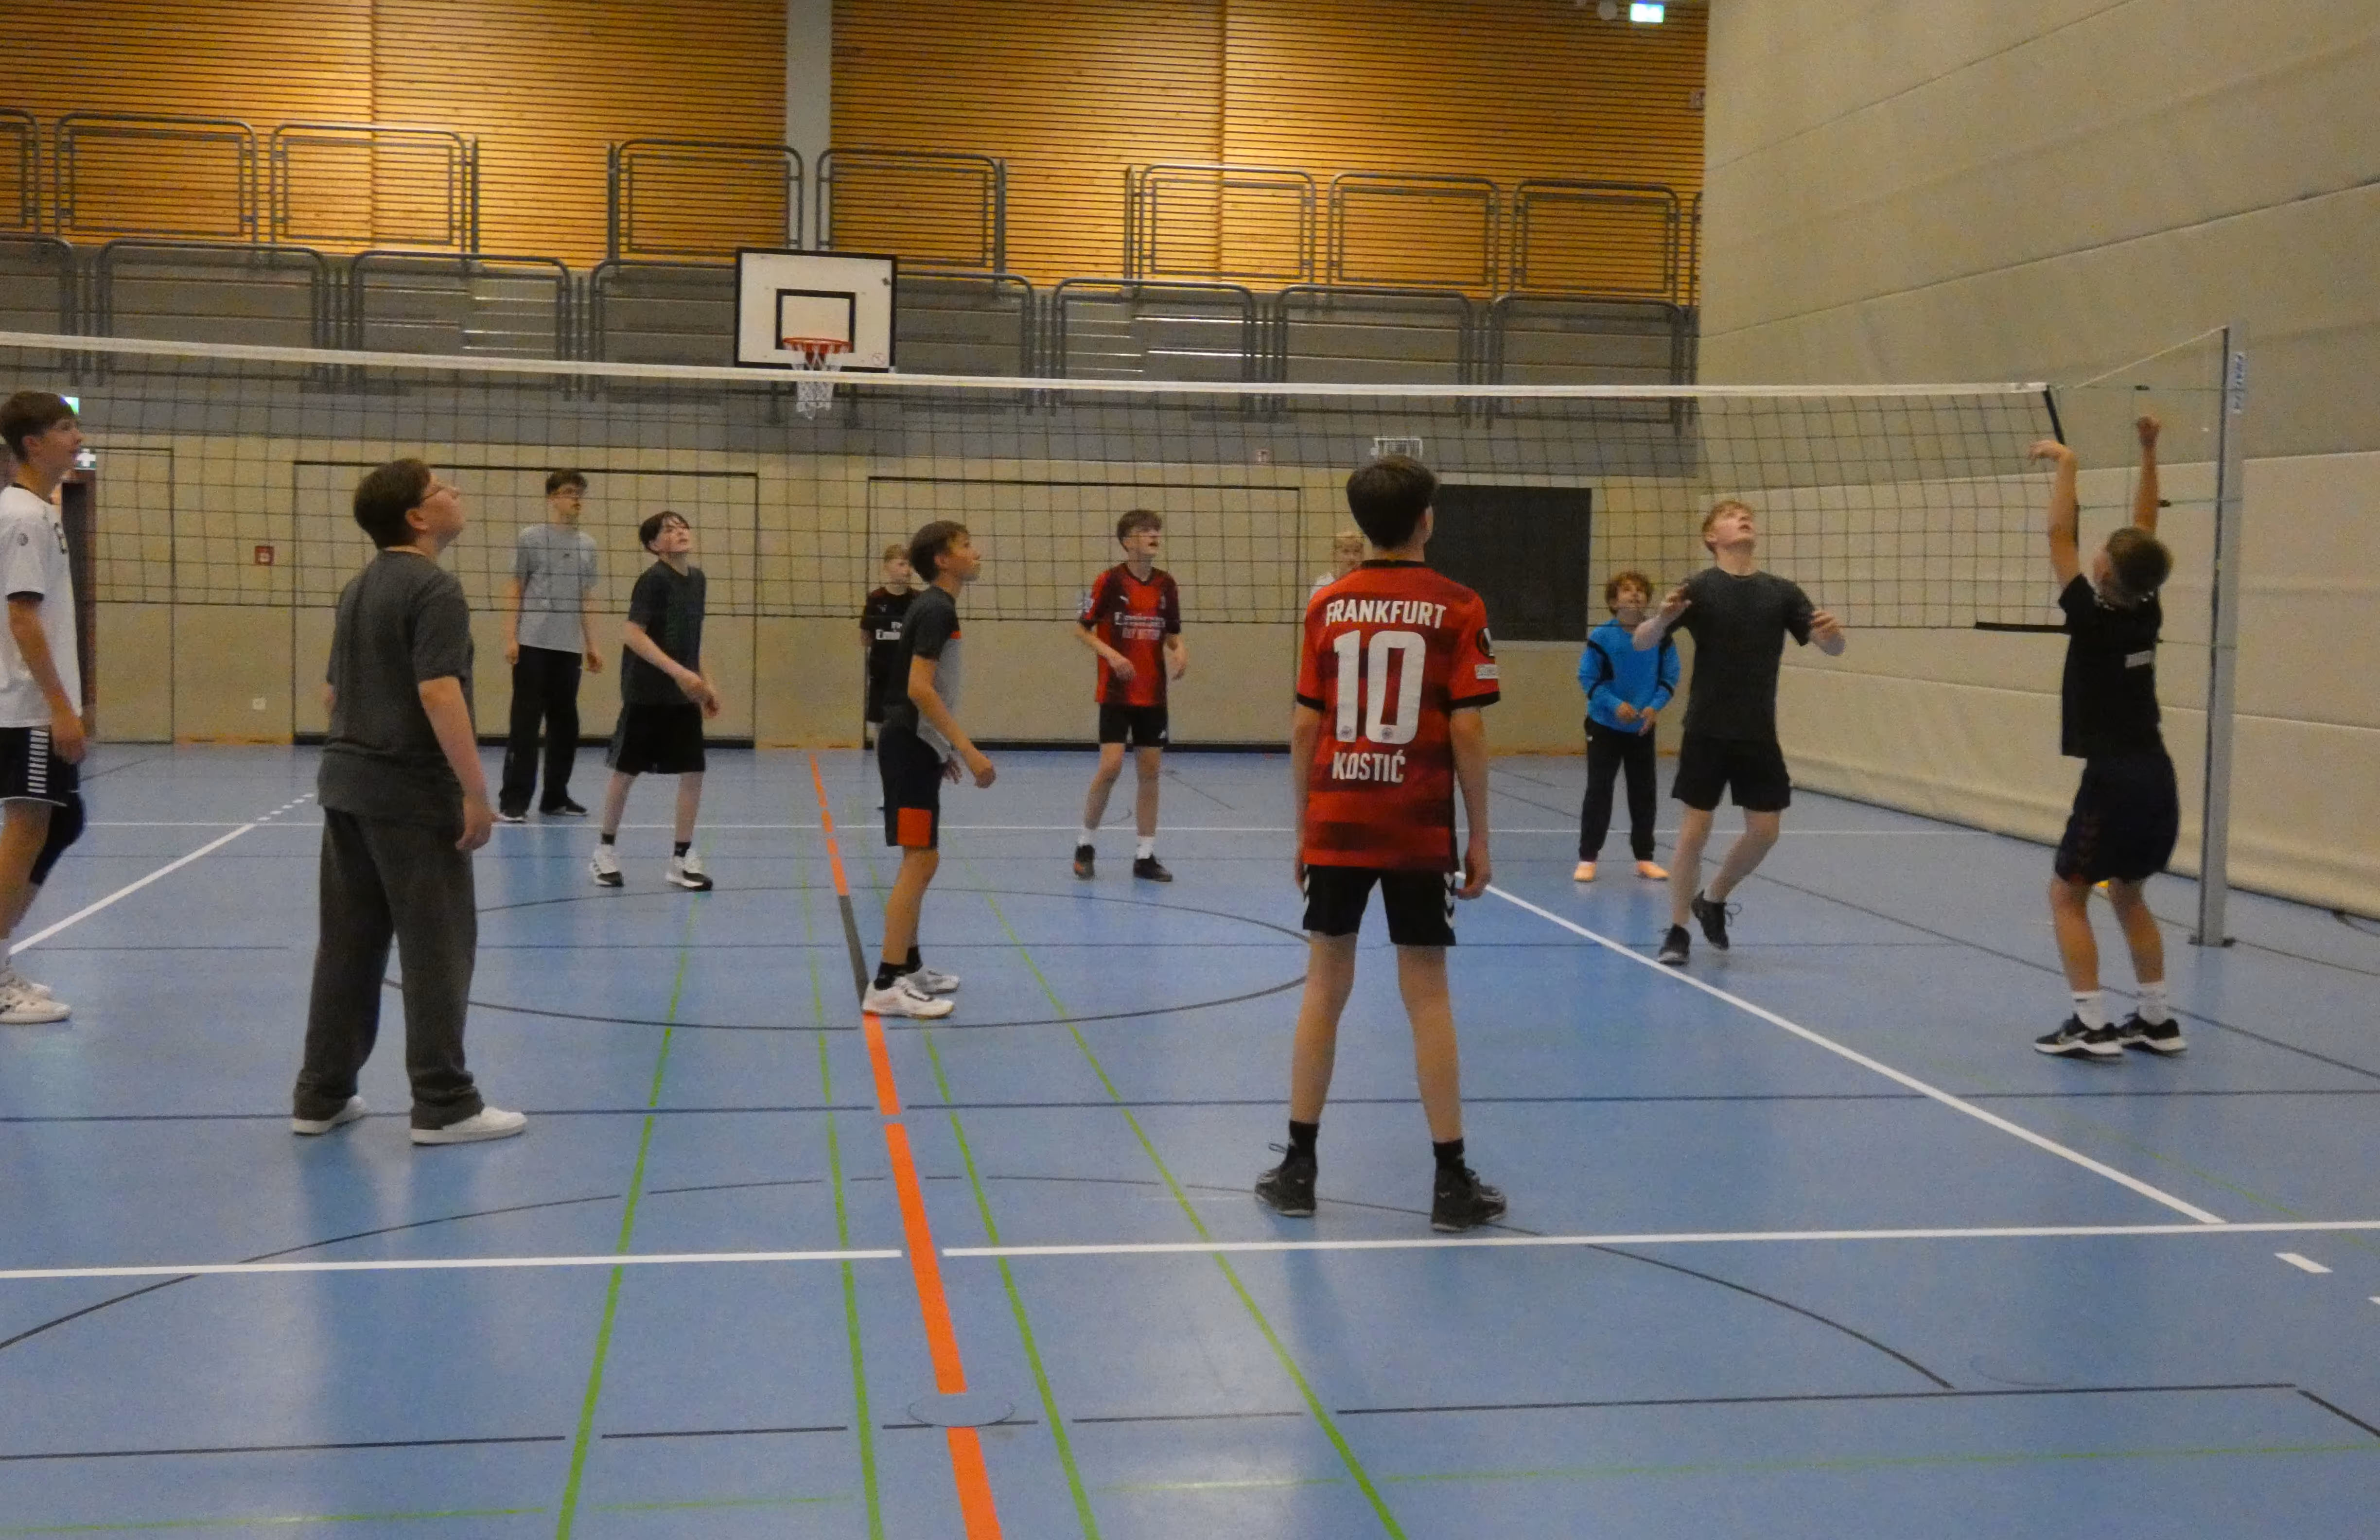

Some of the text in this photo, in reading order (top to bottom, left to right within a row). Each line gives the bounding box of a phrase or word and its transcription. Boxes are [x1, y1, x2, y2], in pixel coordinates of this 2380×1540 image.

[1326, 599, 1447, 629] FRANKFURT
[1333, 630, 1426, 744] 10
[1332, 750, 1406, 783] KOSTIĆ
